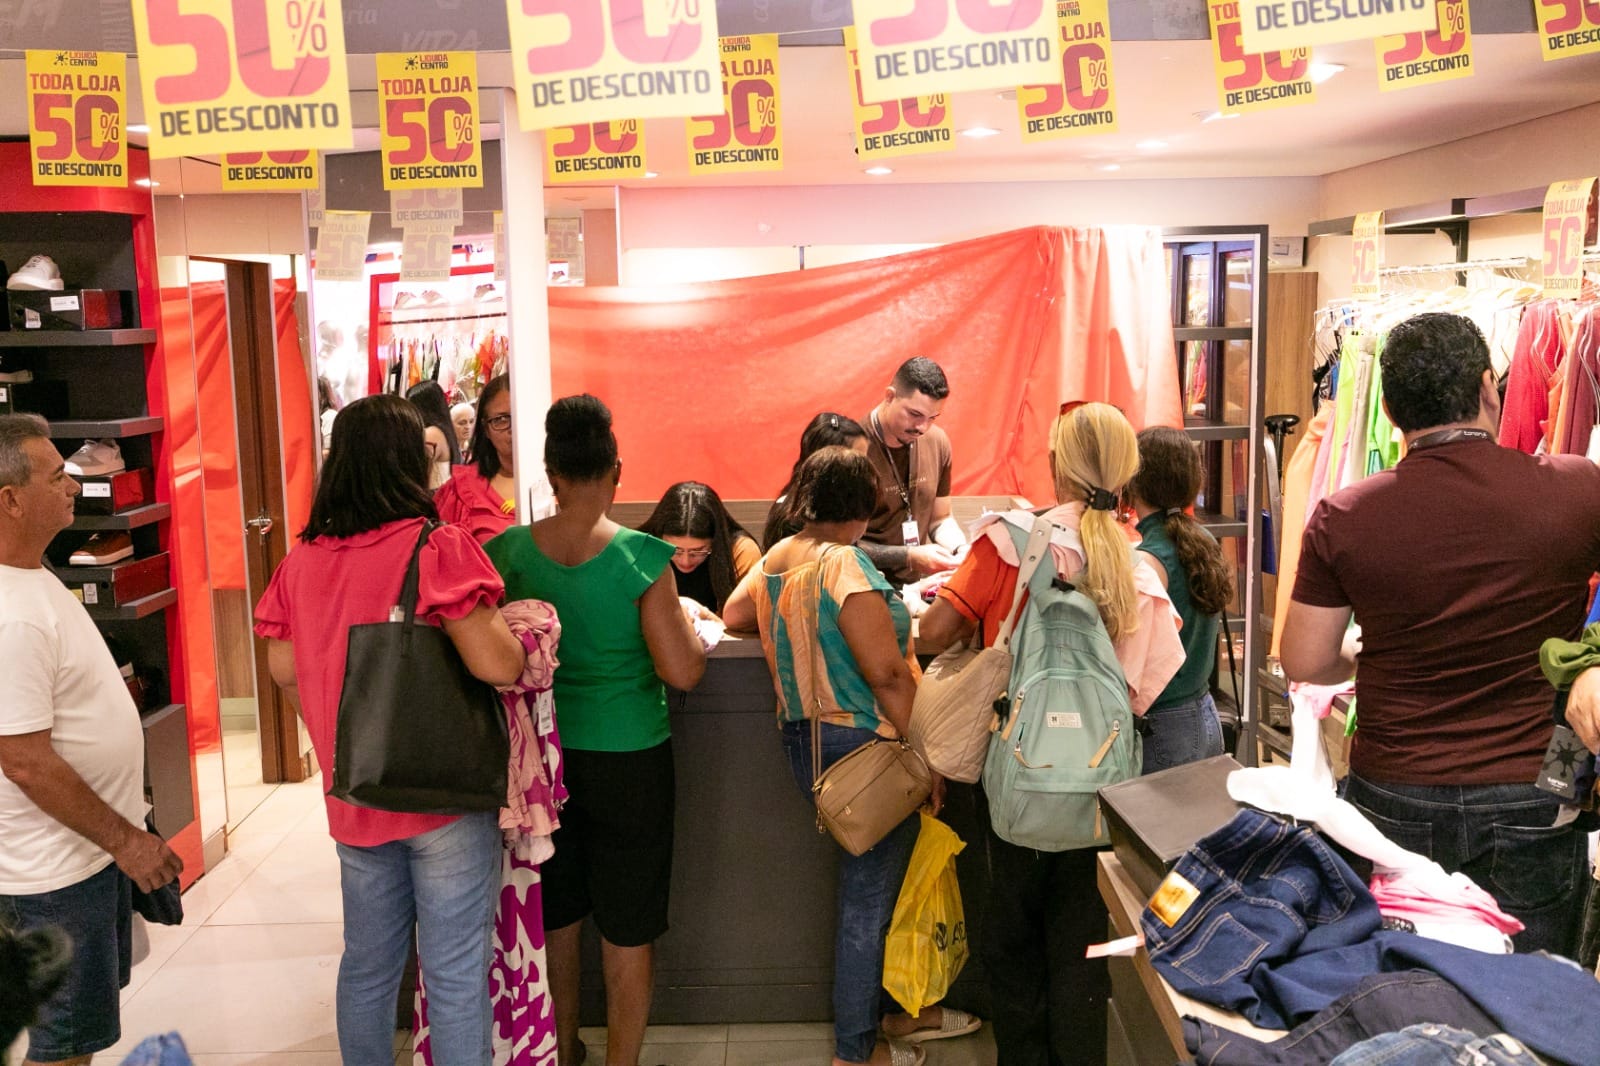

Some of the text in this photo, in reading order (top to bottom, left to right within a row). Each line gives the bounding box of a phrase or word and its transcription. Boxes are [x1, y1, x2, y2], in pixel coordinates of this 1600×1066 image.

[1057, 8, 1081, 17] ENTRO
[1256, 3, 1288, 31] DE
[722, 36, 750, 45] LIQUIDA
[1061, 21, 1105, 42] LOJA
[723, 44, 751, 52] CENTRO
[1548, 35, 1565, 50] DE
[69, 59, 97, 67] CENTRO
[420, 54, 448, 62] LIQUIDA
[420, 61, 449, 70] CENTRO
[731, 58, 775, 76] LOJA
[875, 52, 908, 80] DE
[914, 37, 1050, 74] DESCONTO
[1387, 54, 1469, 81] DE DESCONTO
[30, 73, 120, 91] TODA LOJA
[381, 76, 472, 96] TODA LOJA
[532, 80, 565, 108] DE
[570, 69, 711, 102] DESCONTO
[1226, 81, 1312, 106] DE DESCONTO
[33, 93, 120, 161] 50%
[160, 103, 339, 137] DE DESCONTO
[1028, 110, 1113, 133] DE DESCONTO
[386, 96, 474, 165] 50%
[865, 128, 950, 151] DE DESCONTO
[555, 155, 641, 173] DE DESCONTO
[695, 148, 779, 165] DE DESCONTO
[38, 162, 122, 177] DE DESCONTO
[228, 166, 313, 180] DE DESCONTO
[390, 165, 477, 180] DE DESCONTO
[397, 209, 460, 221] DE DESCONTO
